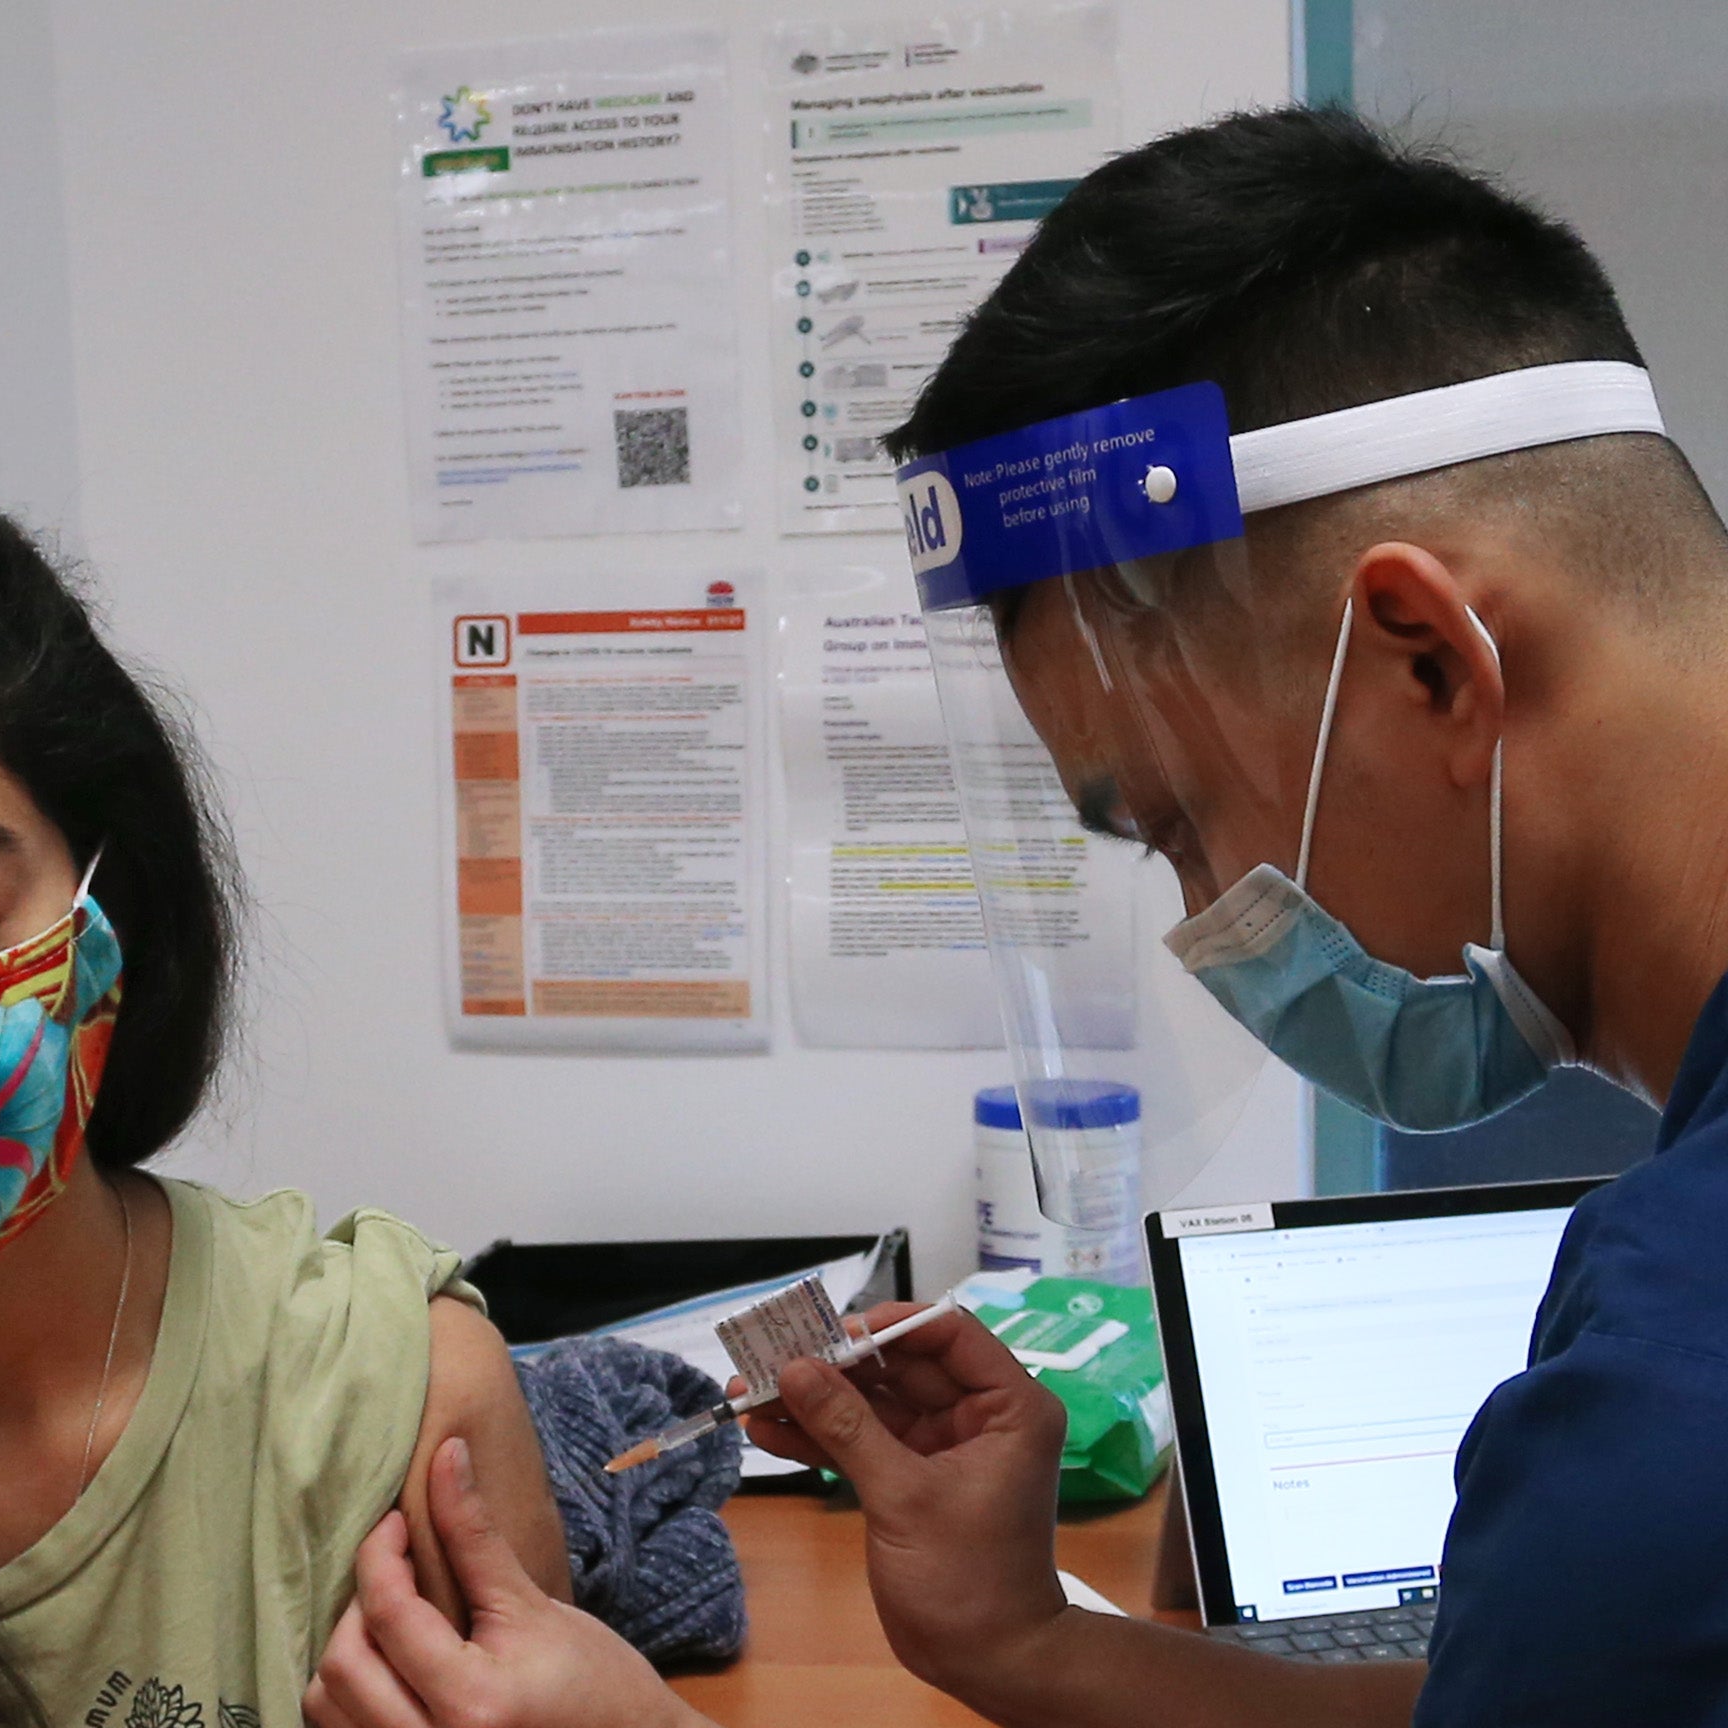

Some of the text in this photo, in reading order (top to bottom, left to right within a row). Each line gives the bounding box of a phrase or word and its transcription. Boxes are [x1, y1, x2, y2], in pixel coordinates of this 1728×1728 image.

[512, 100, 552, 116] DON'T
[556, 98, 591, 112] HAVE
[666, 90, 695, 103] AND
[791, 98, 853, 112] Managing
[937, 87, 964, 101] after
[572, 118, 619, 132] ACCESS
[623, 116, 639, 128] TO
[644, 112, 680, 126] YOUR
[618, 133, 681, 149] HISTORY?
[1044, 442, 1090, 470] gently
[1093, 427, 1156, 454] remove
[998, 466, 1097, 509] protective film
[1002, 494, 1091, 529] before using
[467, 624, 494, 656] N
[823, 639, 867, 652] Group
[1179, 1219, 1201, 1229] VAX
[1204, 1215, 1239, 1226] Station
[1273, 1479, 1310, 1491] Notes
